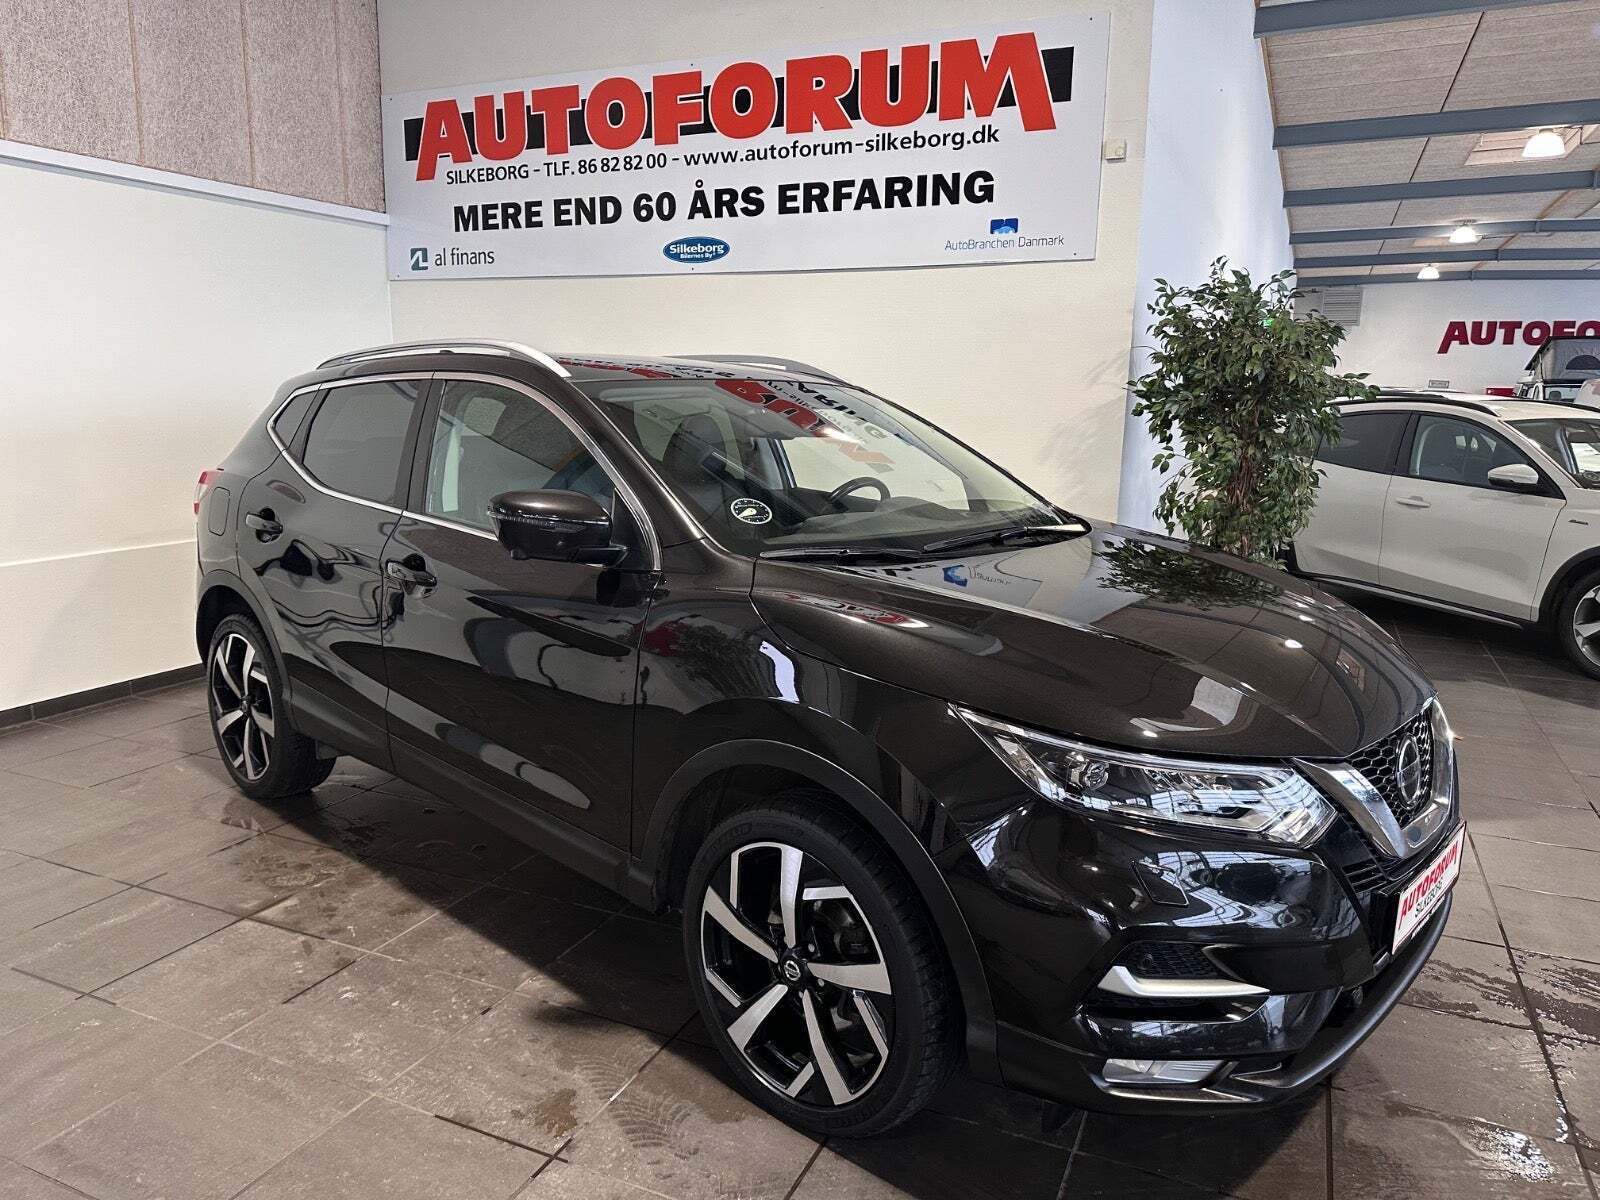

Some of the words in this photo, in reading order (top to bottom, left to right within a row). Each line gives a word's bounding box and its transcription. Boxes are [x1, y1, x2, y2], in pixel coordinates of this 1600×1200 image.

[415, 31, 1057, 182] AUTOFORUM
[446, 164, 529, 185] SILKEBORG
[543, 160, 575, 177] TLF.
[683, 124, 1000, 166] www.autoforum-silkeborg.dk
[453, 200, 544, 233] MERE
[553, 195, 623, 227] END
[632, 191, 677, 223] 60
[687, 179, 765, 221] ÅRS
[777, 170, 995, 216] ERFARING
[434, 248, 448, 267] al
[450, 247, 495, 266] finans
[669, 243, 725, 254] Silkeborg
[945, 237, 1015, 251] AutoBranchen
[1017, 234, 1065, 248] Danmark
